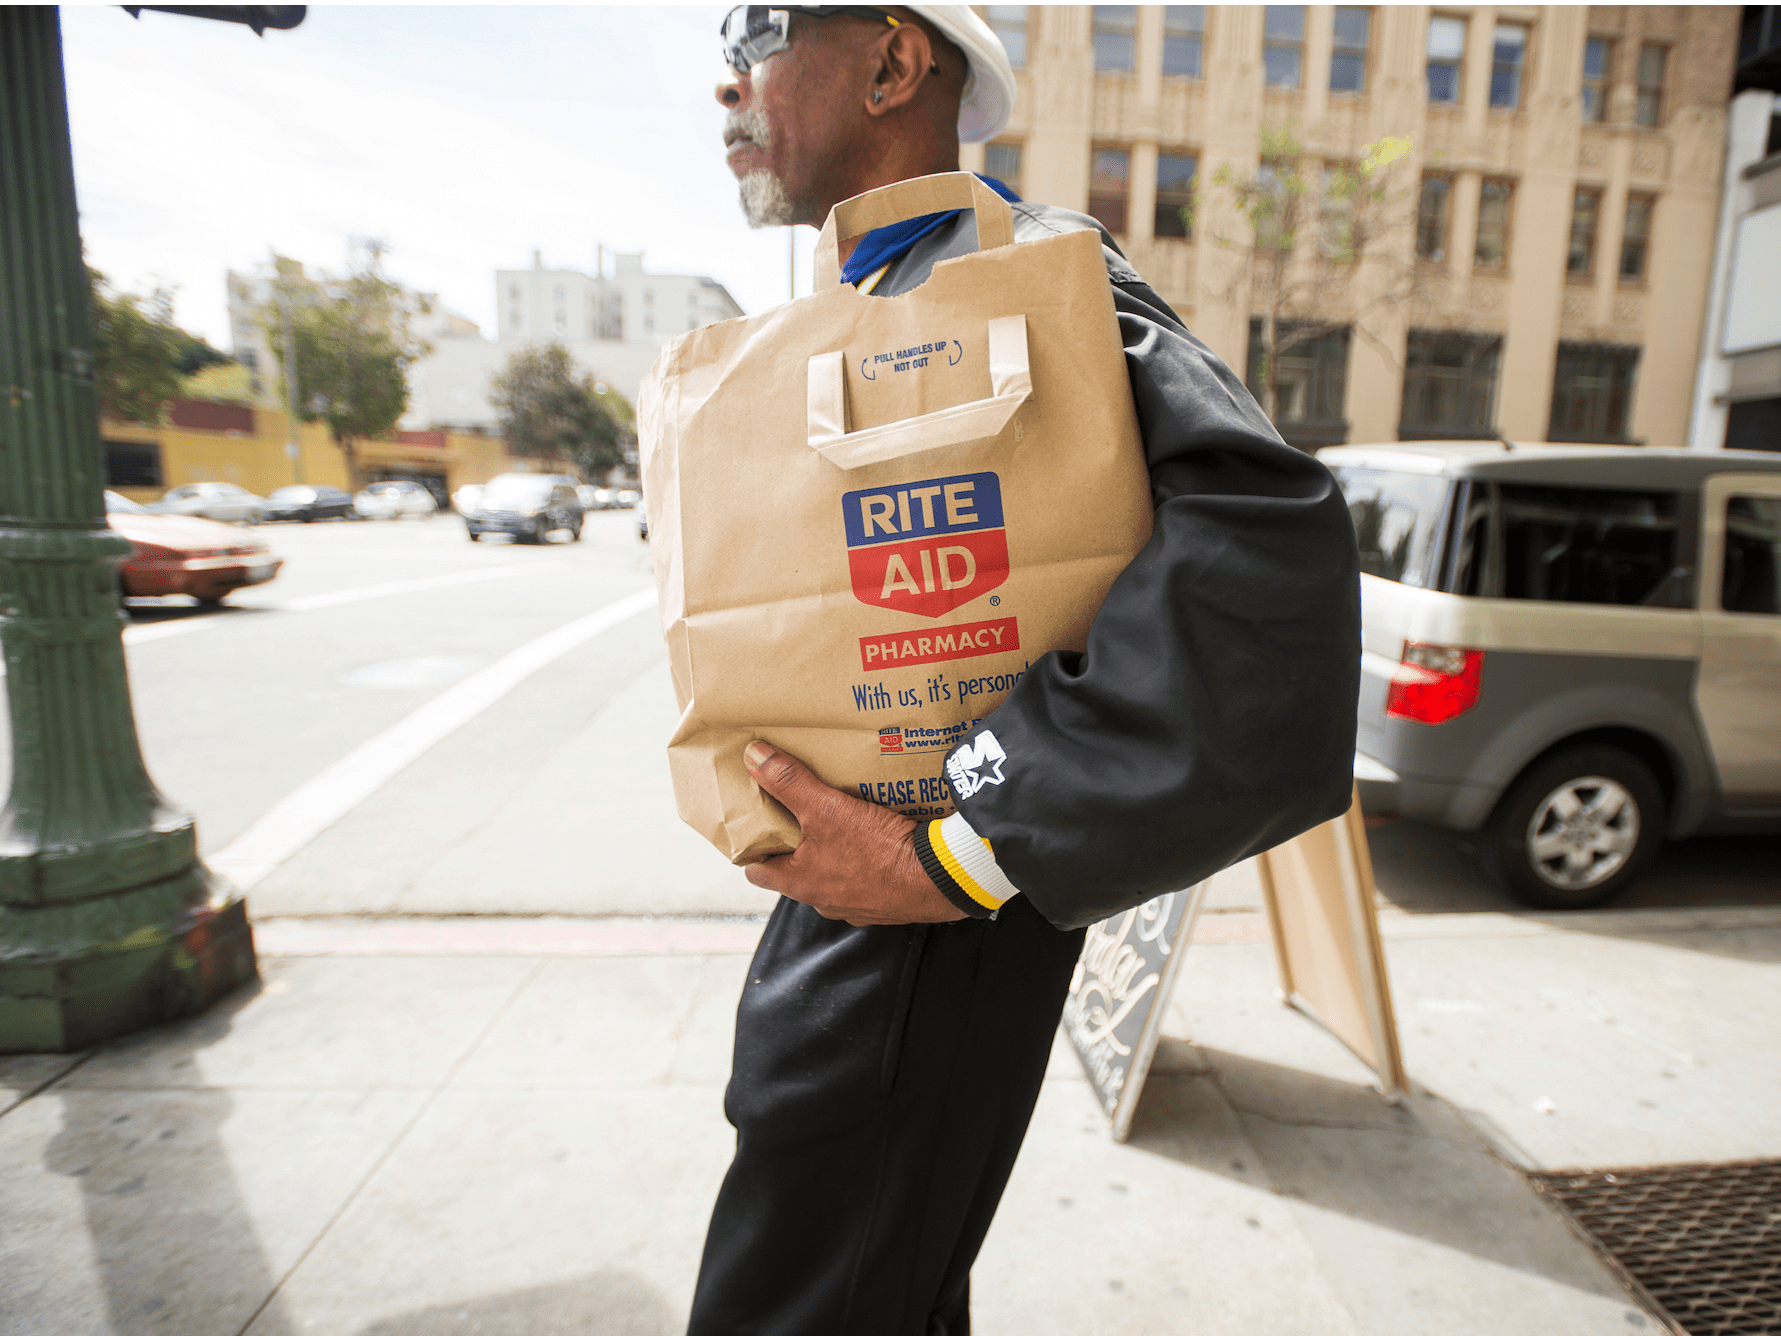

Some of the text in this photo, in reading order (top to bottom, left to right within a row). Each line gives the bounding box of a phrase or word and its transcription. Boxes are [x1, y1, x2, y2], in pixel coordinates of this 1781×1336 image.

[874, 341, 947, 364] PULL HANDLES UP
[894, 357, 929, 372] NOT OUT
[860, 481, 979, 538] RITE
[880, 545, 976, 600] AID
[865, 625, 1006, 663] PHARMACY
[852, 682, 892, 712] With
[898, 688, 923, 708] us,
[927, 674, 951, 703] it's
[904, 721, 968, 738] Internet
[905, 734, 965, 748] www.rit
[859, 777, 948, 806] PLEASE REC
